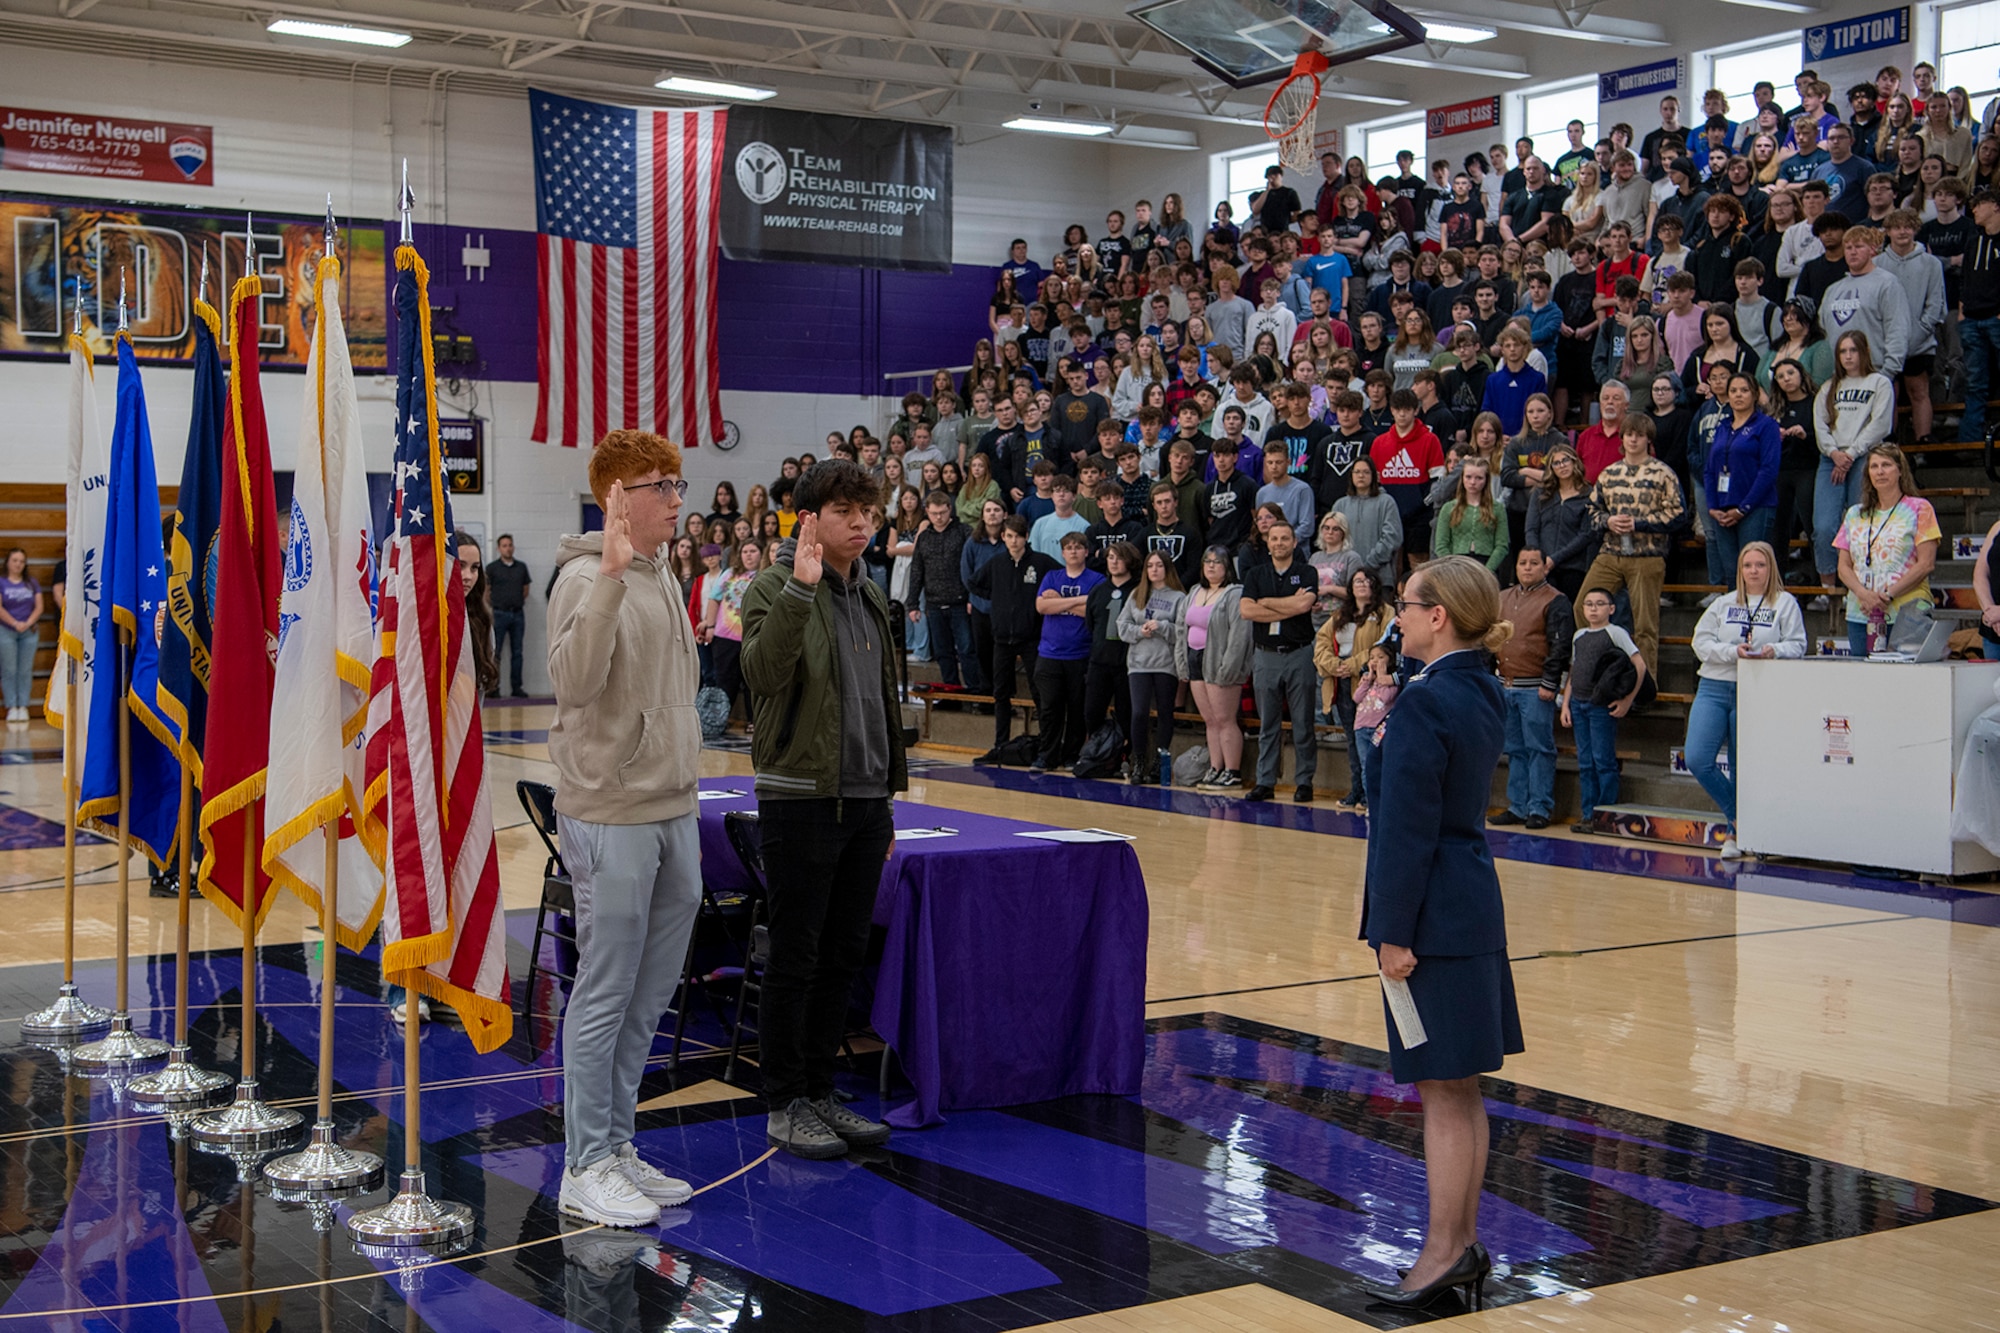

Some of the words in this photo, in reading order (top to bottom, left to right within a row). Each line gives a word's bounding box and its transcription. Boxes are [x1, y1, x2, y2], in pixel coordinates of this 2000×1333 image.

[1833, 15, 1895, 50] TIPTON
[1618, 65, 1676, 91] NORTHWESTERN
[2, 112, 93, 137] Jennifer
[96, 121, 166, 144] Newell
[1447, 108, 1470, 128] LEWIS
[1471, 104, 1492, 123] CASS
[29, 134, 142, 157] 765-434-7779
[787, 147, 841, 172] TEAM
[788, 168, 936, 201] REHABILITATION
[788, 192, 857, 211] PHYSICAL
[861, 198, 924, 216] THERAPY
[764, 214, 904, 236] WWW.TEAM-REHAB.COM
[1382, 465, 1420, 478] adidas
[1727, 606, 1777, 623] NORTHESTERN
